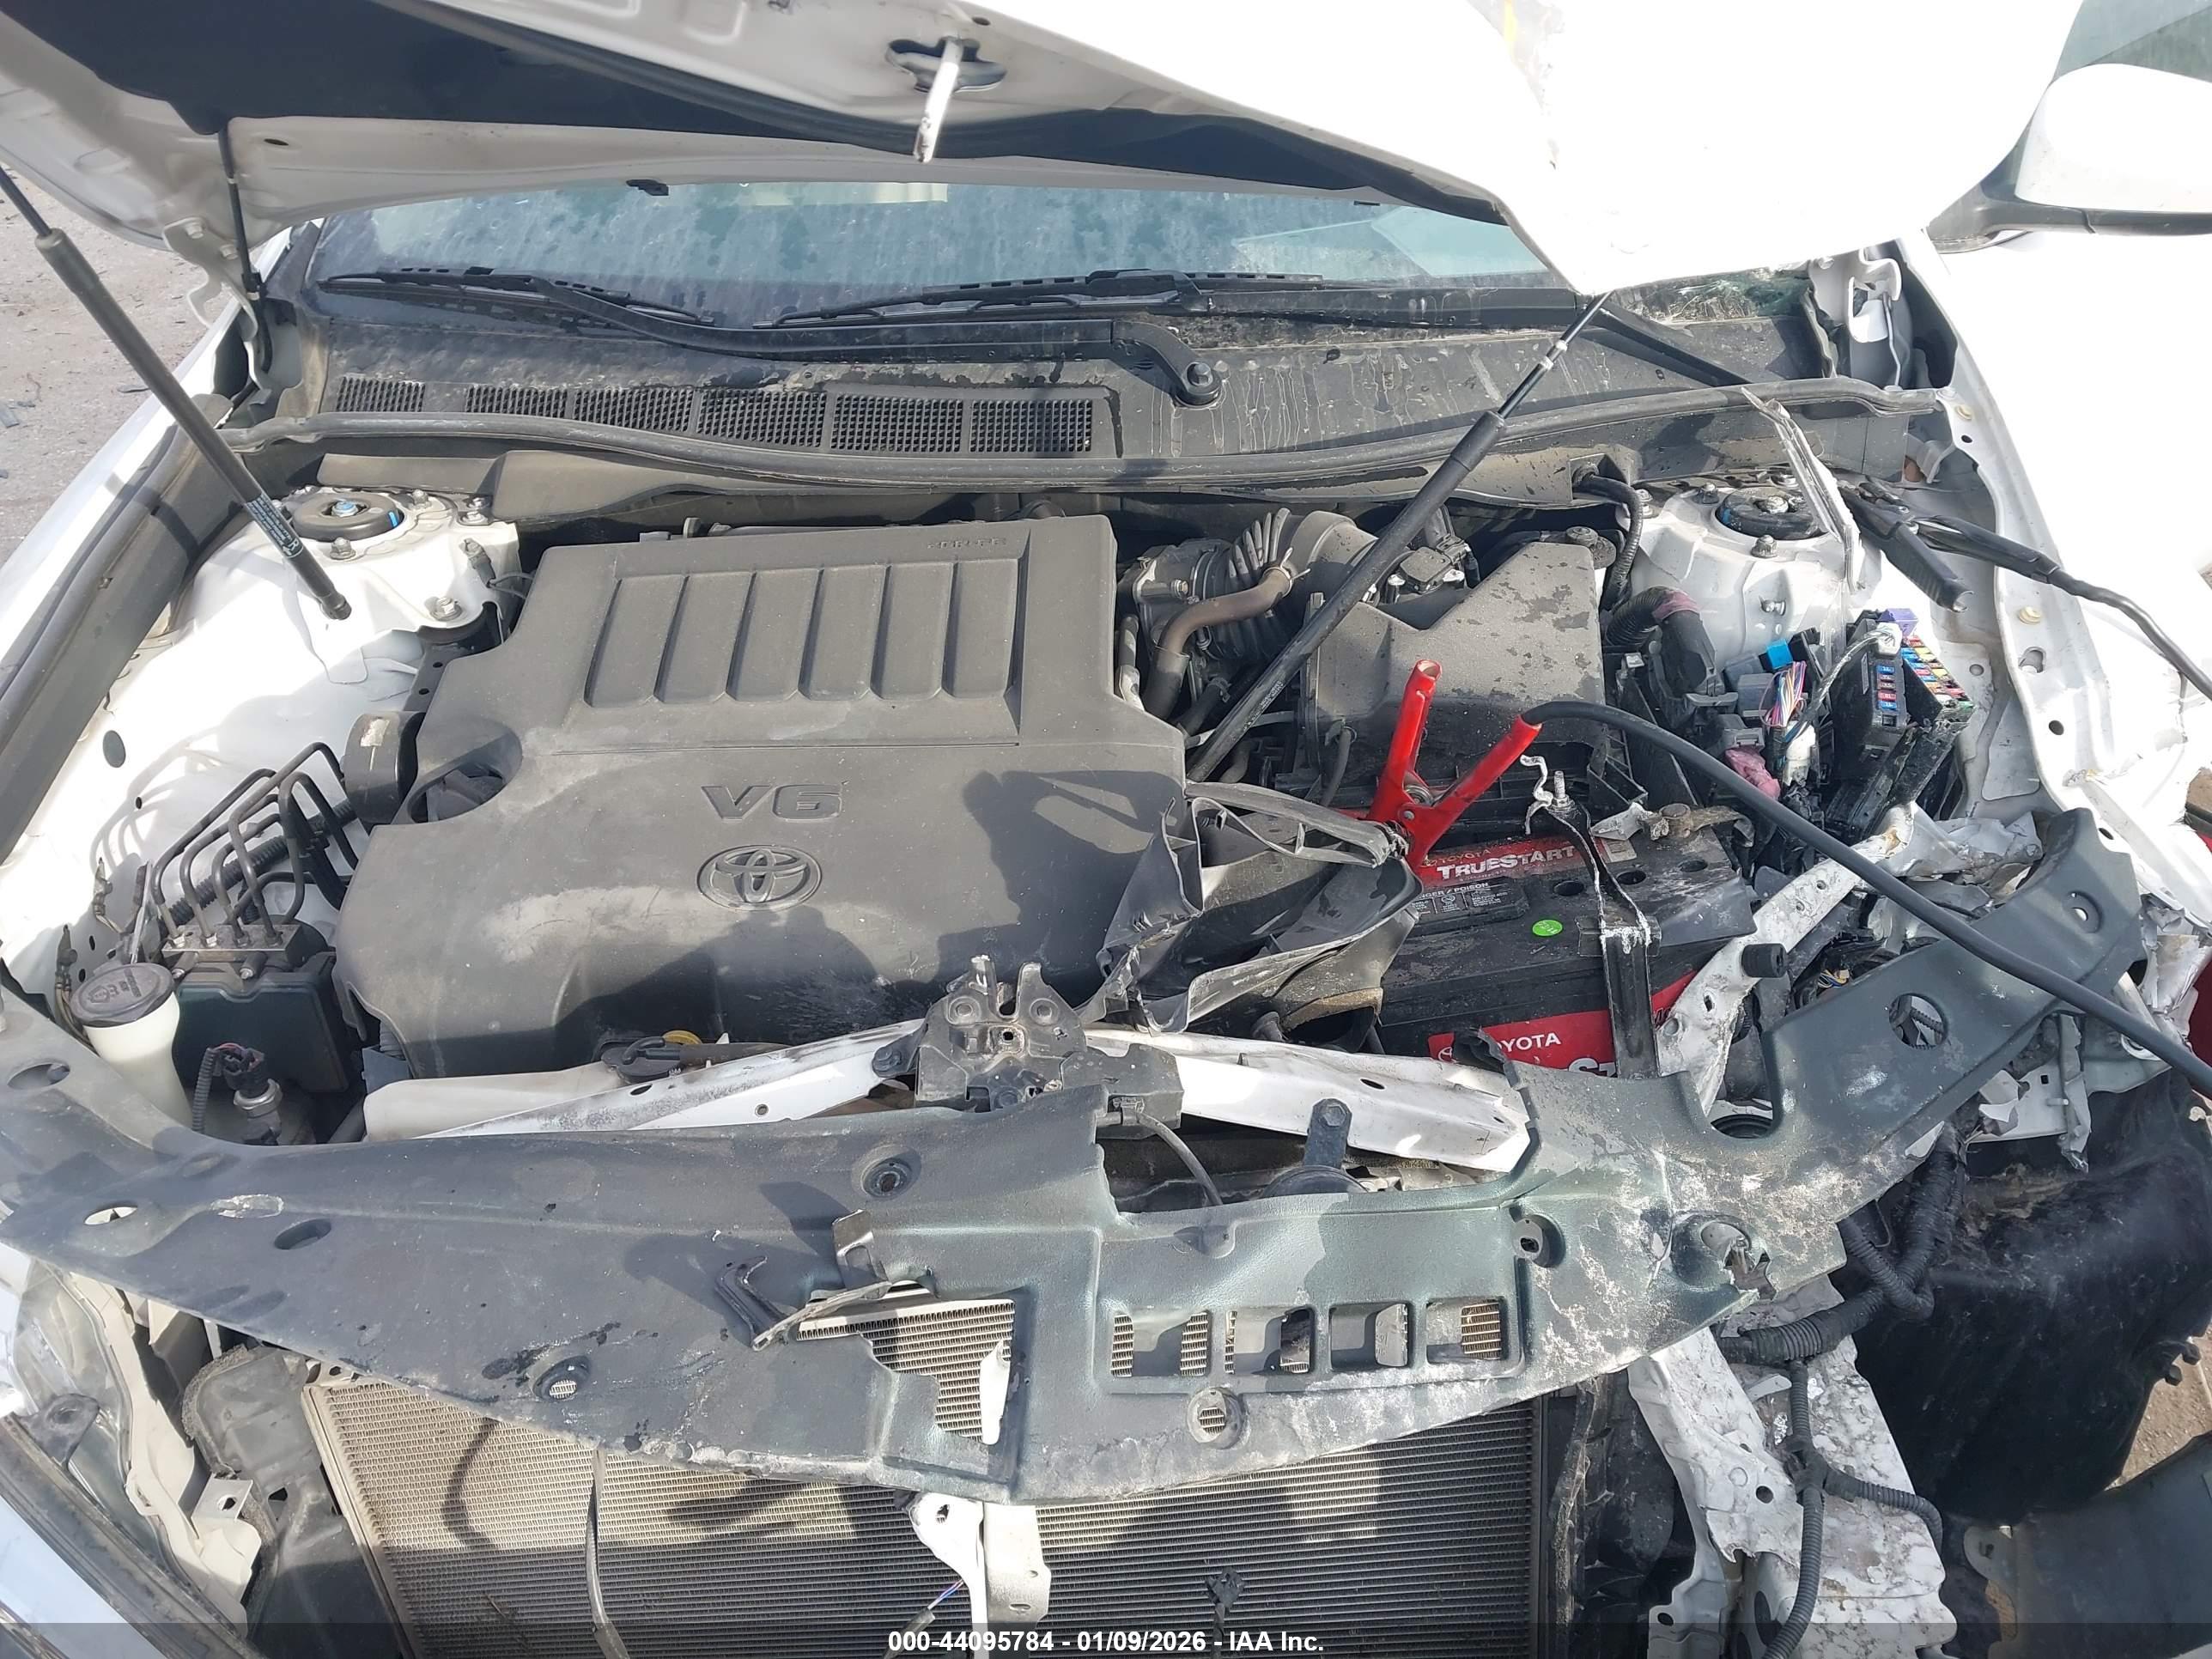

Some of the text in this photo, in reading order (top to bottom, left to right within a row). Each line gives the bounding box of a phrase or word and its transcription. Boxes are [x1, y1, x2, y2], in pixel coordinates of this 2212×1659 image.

[288, 538, 300, 551] R
[701, 785, 842, 822] V6
[1437, 845, 1575, 880] TRUESTART
[1441, 848, 1492, 864] TOYOTA
[1419, 890, 1444, 899] NGER
[1454, 882, 1489, 892] POISON
[1498, 1032, 1561, 1052] YOTA
